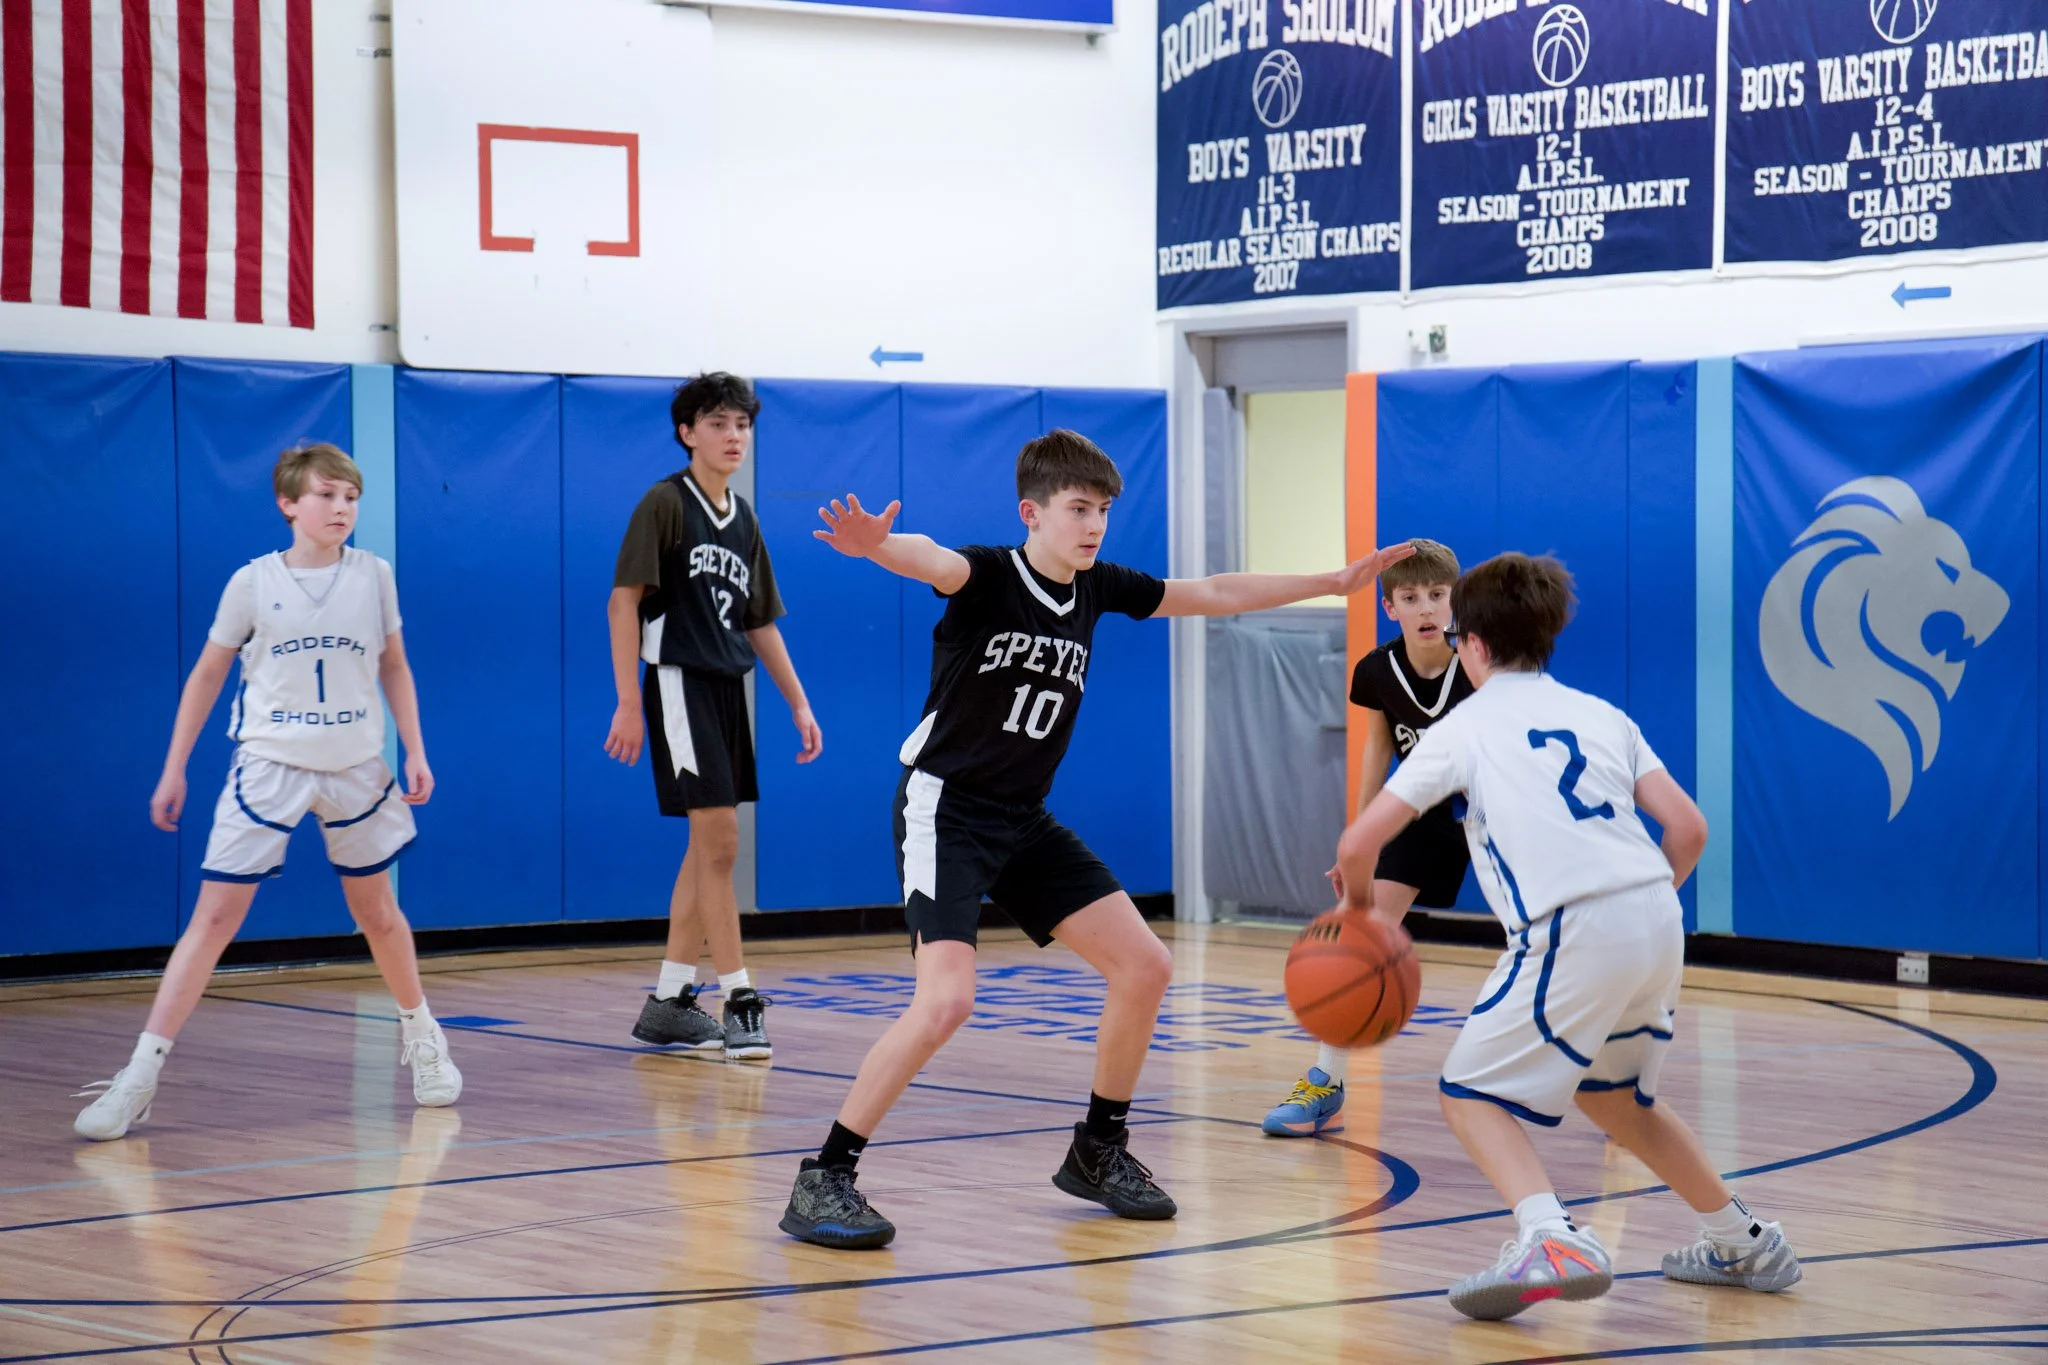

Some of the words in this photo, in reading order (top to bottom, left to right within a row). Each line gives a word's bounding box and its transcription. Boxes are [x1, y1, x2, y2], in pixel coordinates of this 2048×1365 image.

[1162, 0, 1268, 92] RODEPH
[1283, 0, 1396, 58] SHOLOM
[1740, 61, 1804, 112] BOYS
[1817, 47, 1912, 104] VARSITY
[1422, 96, 1477, 143] GIRLS
[1486, 88, 1568, 137] VARSITY
[1574, 73, 1709, 130] BASKETBALL
[1875, 93, 1933, 127] 12-4
[1188, 137, 1249, 183] BOYS
[1265, 123, 1366, 173] VARSITY
[1536, 131, 1581, 161] 12-1
[1847, 123, 1955, 161] A.I.P.S.L.
[1516, 157, 1604, 191] A.I.P.S.L.
[1881, 138, 2048, 187] TOURNAMEN
[1258, 172, 1296, 205] 11-3
[1848, 181, 1951, 220] CHAMPS
[1239, 200, 1320, 237] A.I.P.S.L.
[1517, 214, 1604, 247] CHAMPS
[1860, 213, 1937, 247] 2008
[1159, 237, 1242, 276] REGULAR
[1246, 230, 1317, 265] SEASON
[1321, 221, 1400, 258] CHAMPS
[1526, 242, 1592, 274] 2008
[1253, 260, 1299, 293] 2007
[271, 636, 366, 659] RODEPH
[314, 659, 325, 703] 1
[271, 708, 367, 726] SHOLOM
[1002, 684, 1064, 740] 10
[1527, 728, 1615, 821] 2
